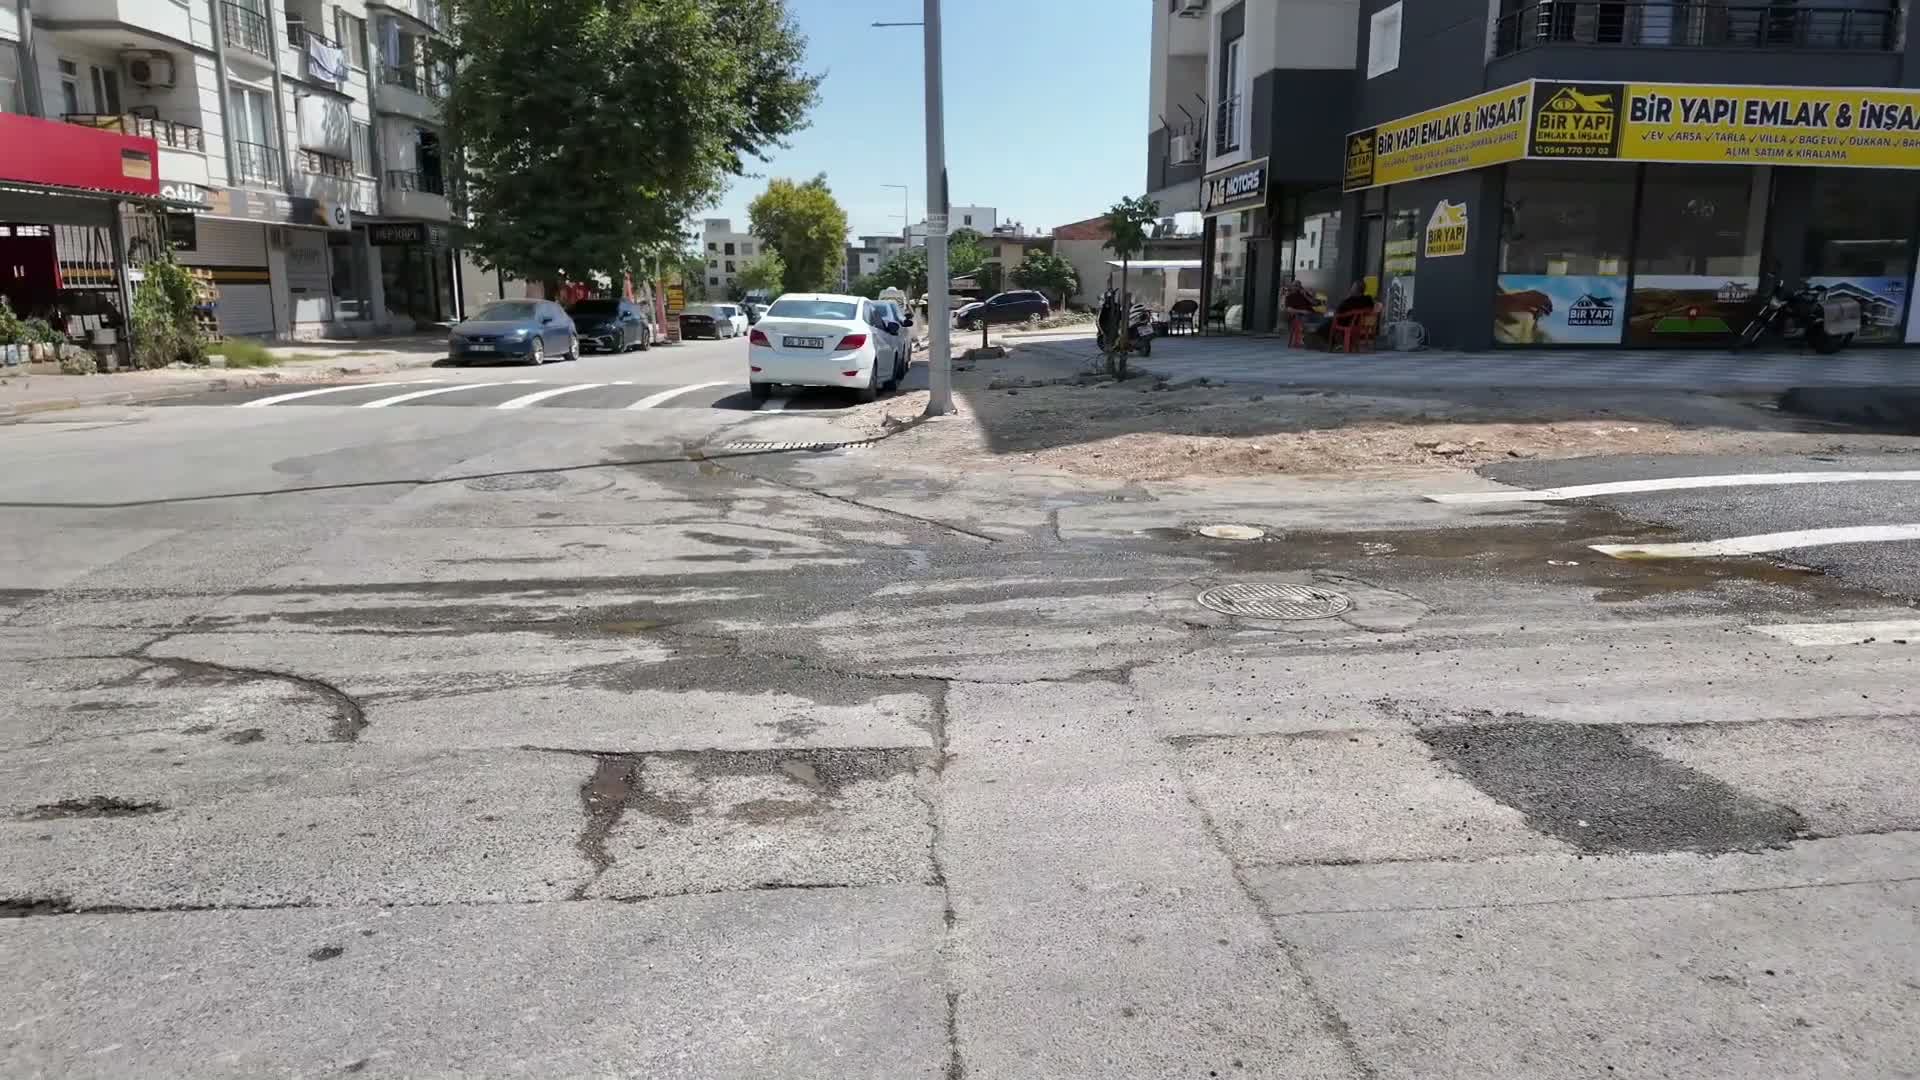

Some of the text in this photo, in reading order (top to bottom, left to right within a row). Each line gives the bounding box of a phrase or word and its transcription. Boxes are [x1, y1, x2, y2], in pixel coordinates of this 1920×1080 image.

[1680, 98, 1737, 125] YAPI
[1744, 100, 1830, 127] EMLAK
[1835, 103, 1852, 128] &
[1574, 116, 1611, 130] YAPI
[1396, 127, 1418, 150] YAPI
[1422, 115, 1460, 144] EMLAK
[1463, 112, 1471, 133] &
[1538, 132, 1567, 140] EMLAK
[1651, 131, 1664, 140] EV
[1674, 132, 1702, 141] ARSA
[1715, 133, 1746, 142] TARLA
[1567, 146, 1583, 154] 770
[1726, 147, 1750, 157] ALIM
[1754, 148, 1784, 158] SATIM
[1225, 169, 1260, 197] MOTORS
[1444, 227, 1465, 242] YAPI
[1590, 310, 1613, 319] YAPI
